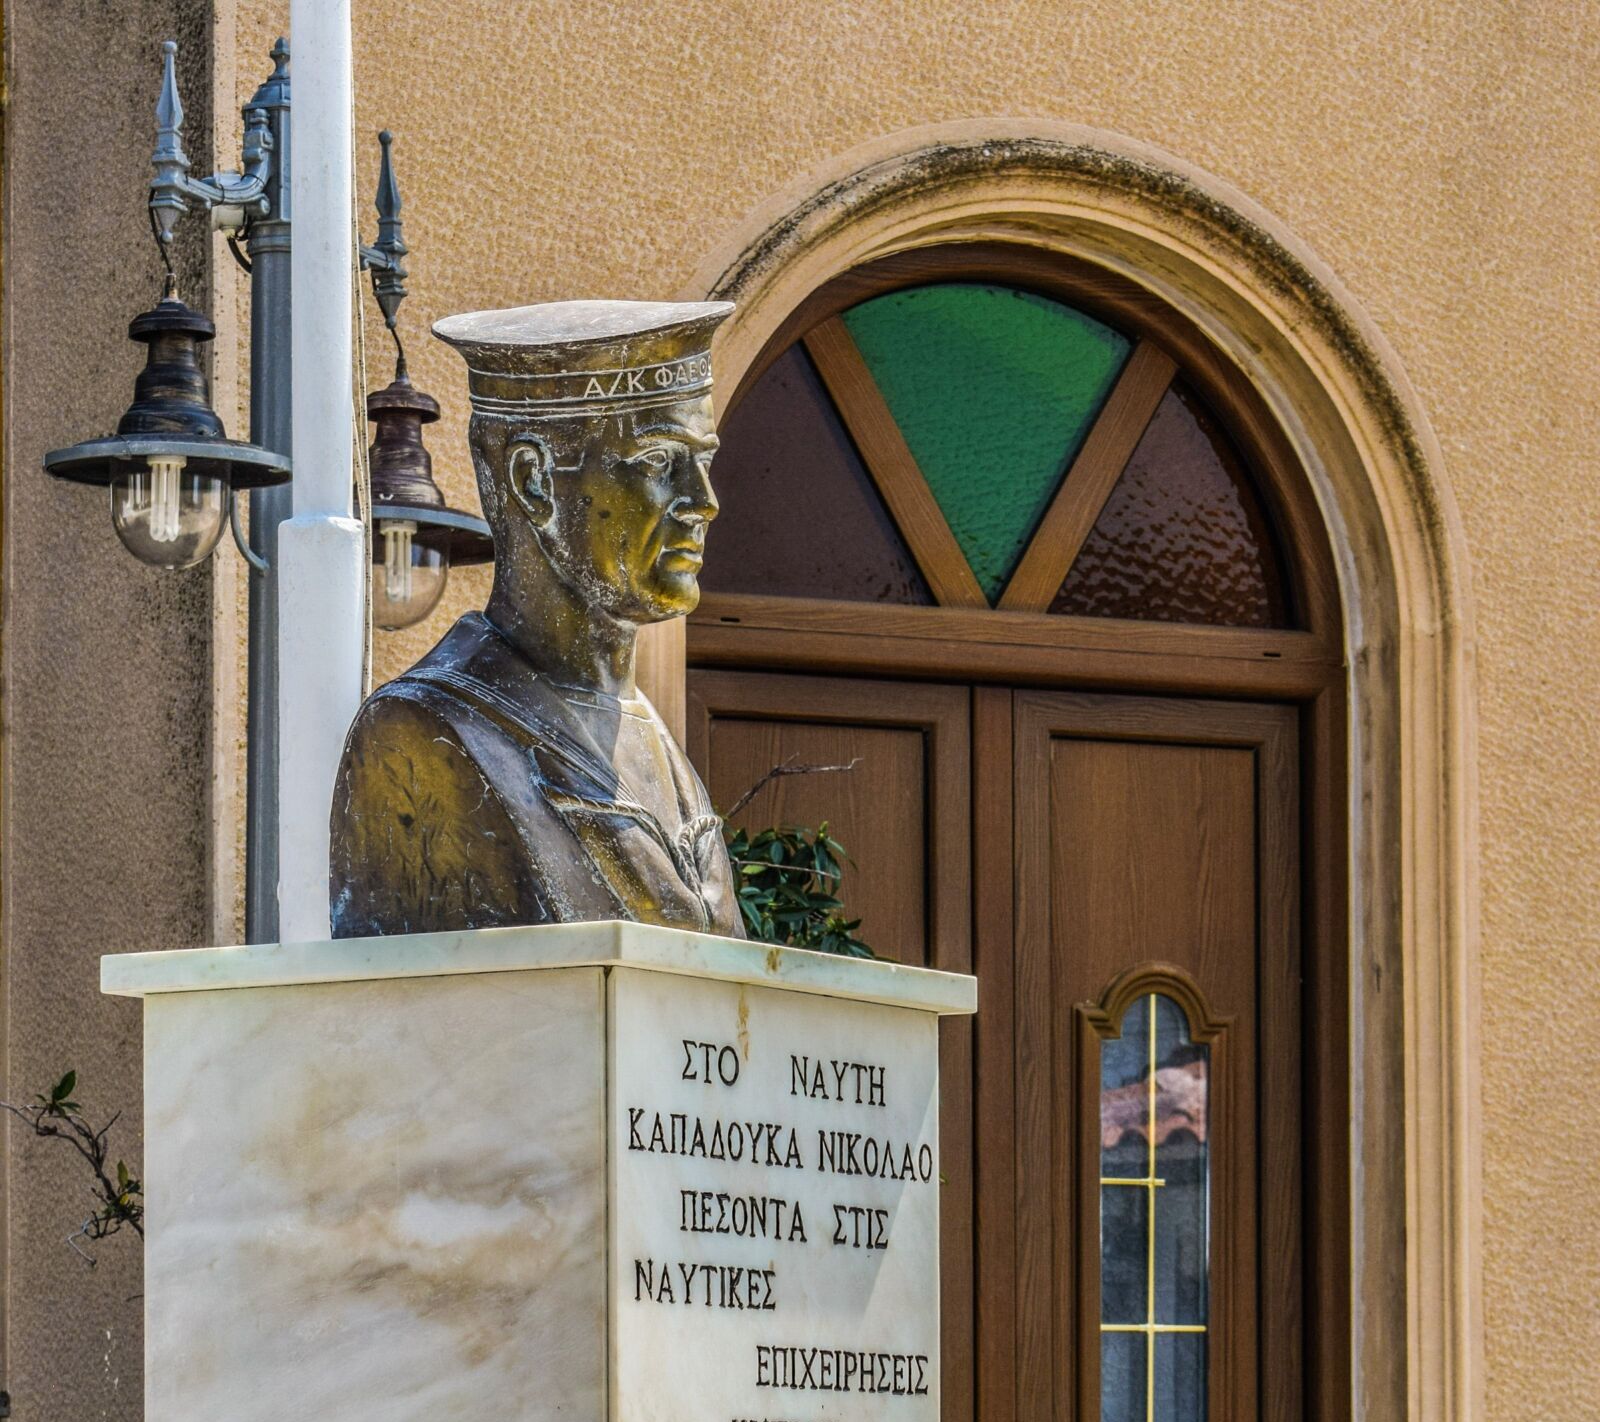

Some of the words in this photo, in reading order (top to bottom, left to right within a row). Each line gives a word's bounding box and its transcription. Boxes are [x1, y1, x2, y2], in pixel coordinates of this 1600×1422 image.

[584, 369, 645, 398] Α/Κ
[682, 1039, 740, 1087] ΣΤΟ
[790, 1054, 887, 1108] ΝΑΥΤΗ
[628, 1107, 804, 1169] ΚΑΠΑΔΟΥΚΑ
[817, 1129, 933, 1184] ΝΙΚΟΛΑΟ
[680, 1189, 808, 1244] ΠΕΣΟΝΤΑ
[832, 1203, 889, 1250] ΣΤΙΣ
[634, 1258, 776, 1311] ΝΑΥΤΙΚΕΣ
[755, 1345, 929, 1396] ΕΠΙΧΕΙΡΗΣΕΙΣ
